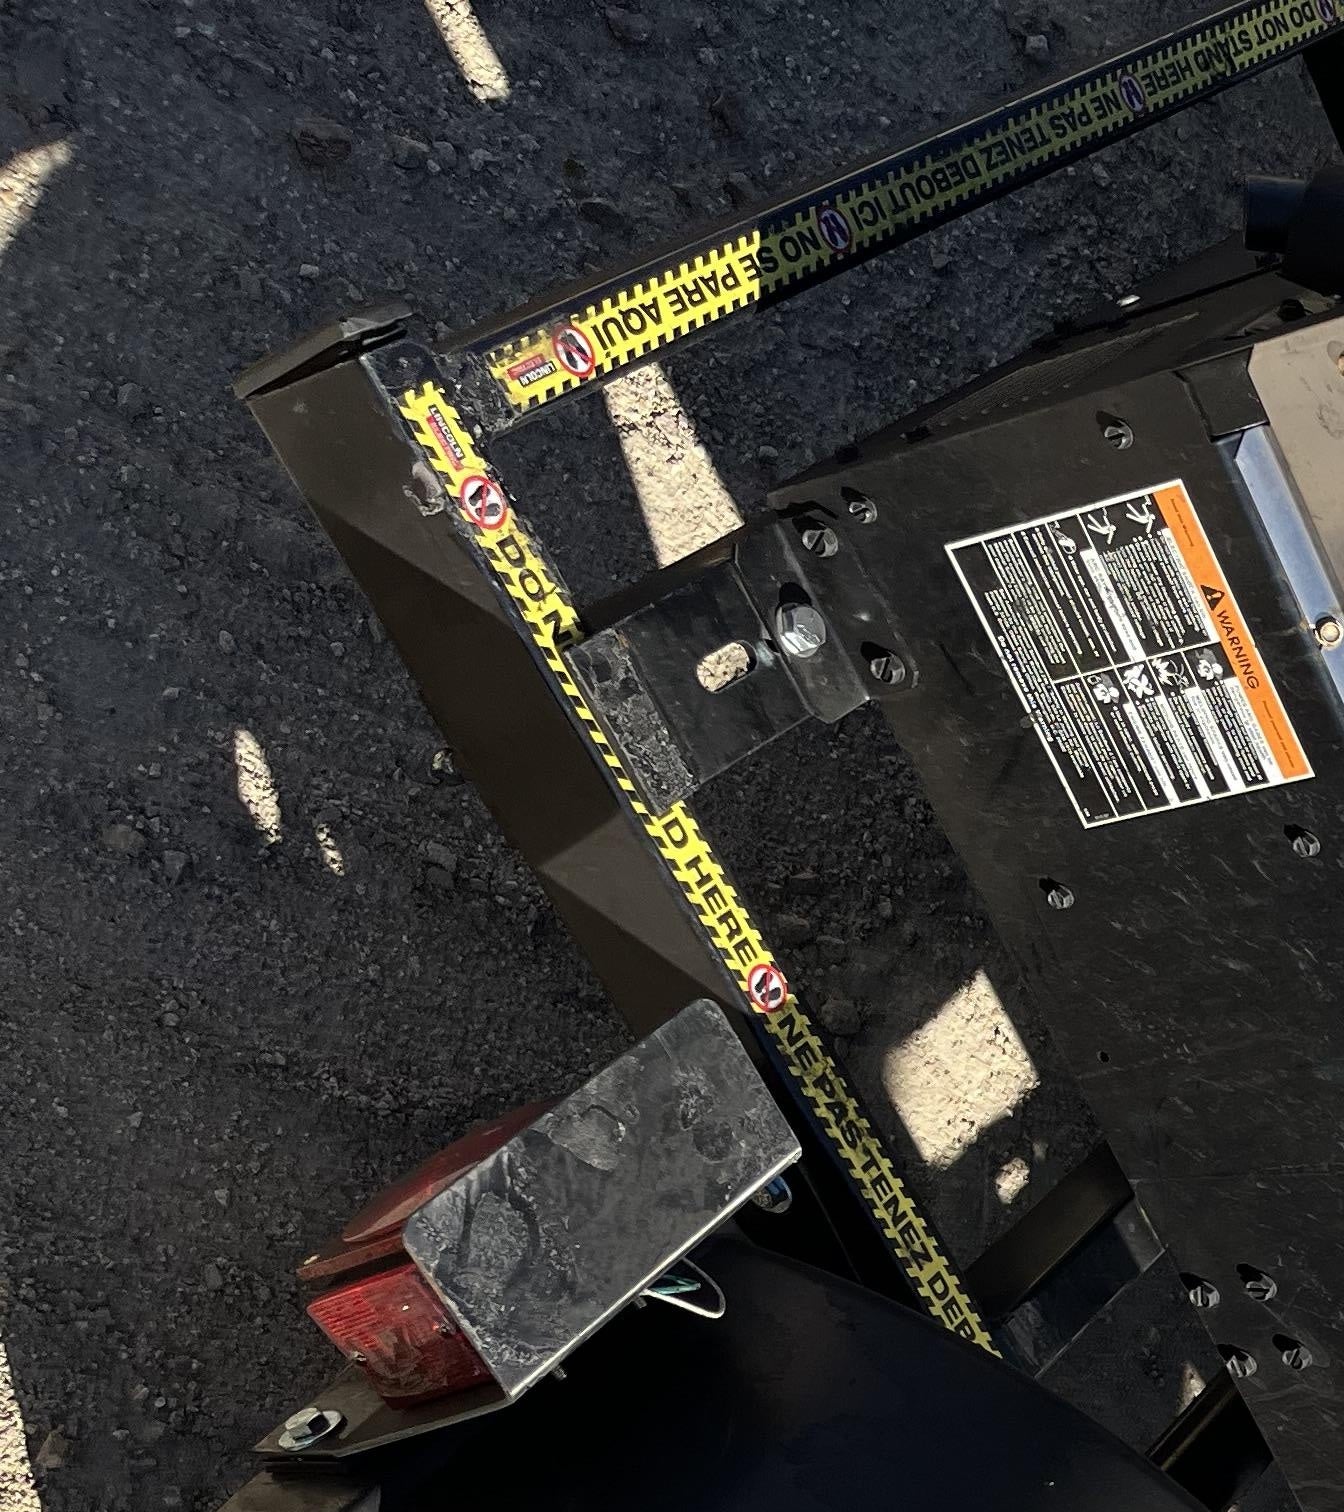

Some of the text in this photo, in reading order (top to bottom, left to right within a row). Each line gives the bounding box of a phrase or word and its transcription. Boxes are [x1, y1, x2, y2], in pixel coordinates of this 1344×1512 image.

[1251, 14, 1289, 45] NOT
[1287, 1, 1317, 29] DO
[1139, 55, 1196, 97] HERE
[848, 88, 1123, 232] NE PAS TENEZ DEBOUT ICI
[737, 244, 780, 281] SE
[775, 224, 822, 264] NO
[665, 261, 741, 316] PARE
[496, 532, 548, 607] DO
[1214, 609, 1261, 689] WARNING
[683, 853, 759, 969] HERE
[776, 1013, 820, 1072] NE
[808, 1070, 864, 1151] PAS
[851, 1144, 934, 1273] TENEZ
